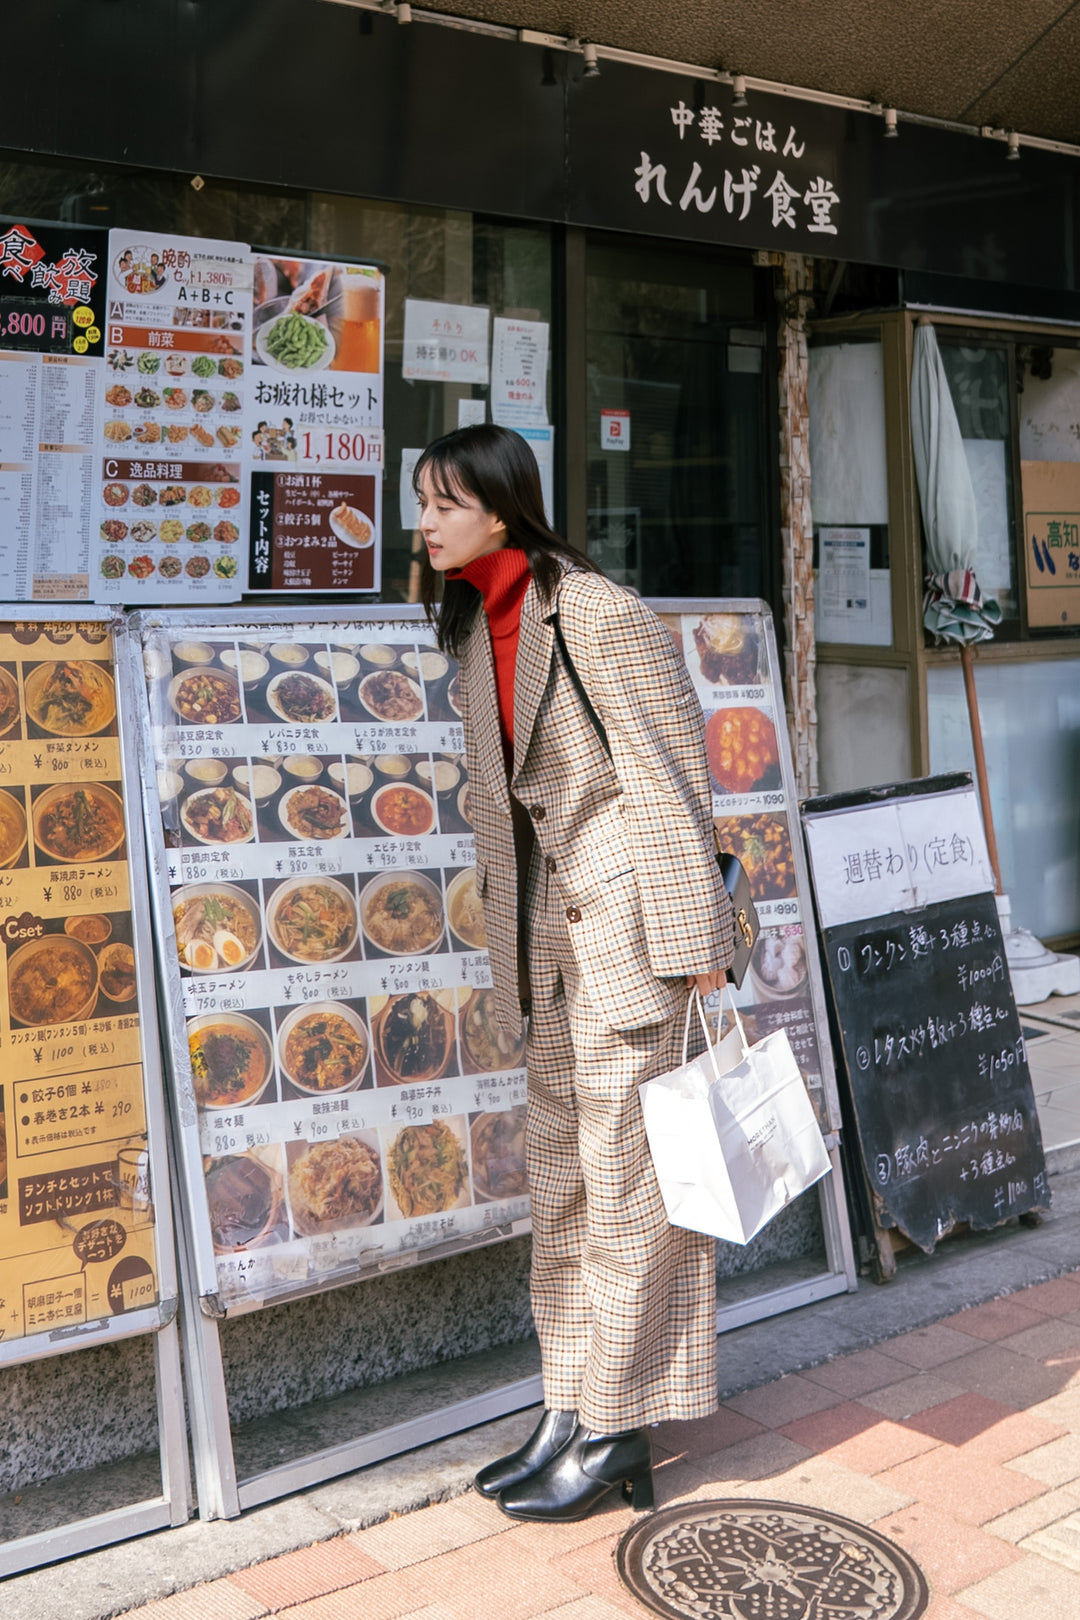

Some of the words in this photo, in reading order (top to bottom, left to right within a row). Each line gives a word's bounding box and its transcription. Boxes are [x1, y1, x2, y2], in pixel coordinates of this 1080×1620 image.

[670, 101, 805, 158] 中華ごはん
[634, 151, 840, 235] れんげ食堂
[162, 248, 191, 269] 晩酌
[111, 303, 123, 318] A
[111, 327, 124, 344] B
[148, 332, 175, 348] 前菜
[461, 349, 478, 362] OK
[254, 380, 378, 411] お疲れ様セット
[302, 431, 381, 464] 1,180円
[106, 460, 119, 478] C
[129, 462, 183, 479] 逸品料理
[254, 490, 271, 575] セット内容
[268, 728, 320, 740] レバニラ定食
[354, 727, 417, 738] しょうが焼き定食
[46, 743, 99, 753] 野菜タンメン
[180, 744, 202, 756] 830
[276, 739, 297, 752] 830
[370, 740, 386, 752] 880
[52, 758, 69, 771] 800
[373, 840, 422, 852] エビチリ定食
[180, 850, 231, 864] 回鍋肉定食
[380, 853, 397, 865] 930
[842, 832, 974, 885] 週替わり(定食)
[186, 866, 207, 879] 880
[290, 859, 308, 872] 880
[50, 869, 113, 882] 豚焼肉ラーメン
[63, 885, 82, 901] 880
[389, 961, 430, 974] ワンタン麺
[287, 969, 348, 984] もやしラーメン
[188, 981, 246, 995] 味玉ラーメン
[394, 978, 409, 990] 800
[302, 986, 319, 1000] 800
[197, 998, 216, 1010] 750
[52, 1046, 74, 1061] 1100
[112, 1101, 132, 1118] 290
[406, 1105, 424, 1119] 930
[311, 1121, 328, 1137] 900
[215, 1135, 236, 1151] 880
[24, 1168, 114, 1198] ランチとセットで
[27, 1287, 82, 1309] 胡麻団子一個
[130, 1284, 153, 1299] 1100
[28, 1304, 83, 1325] ミニ杏仁豆腐
